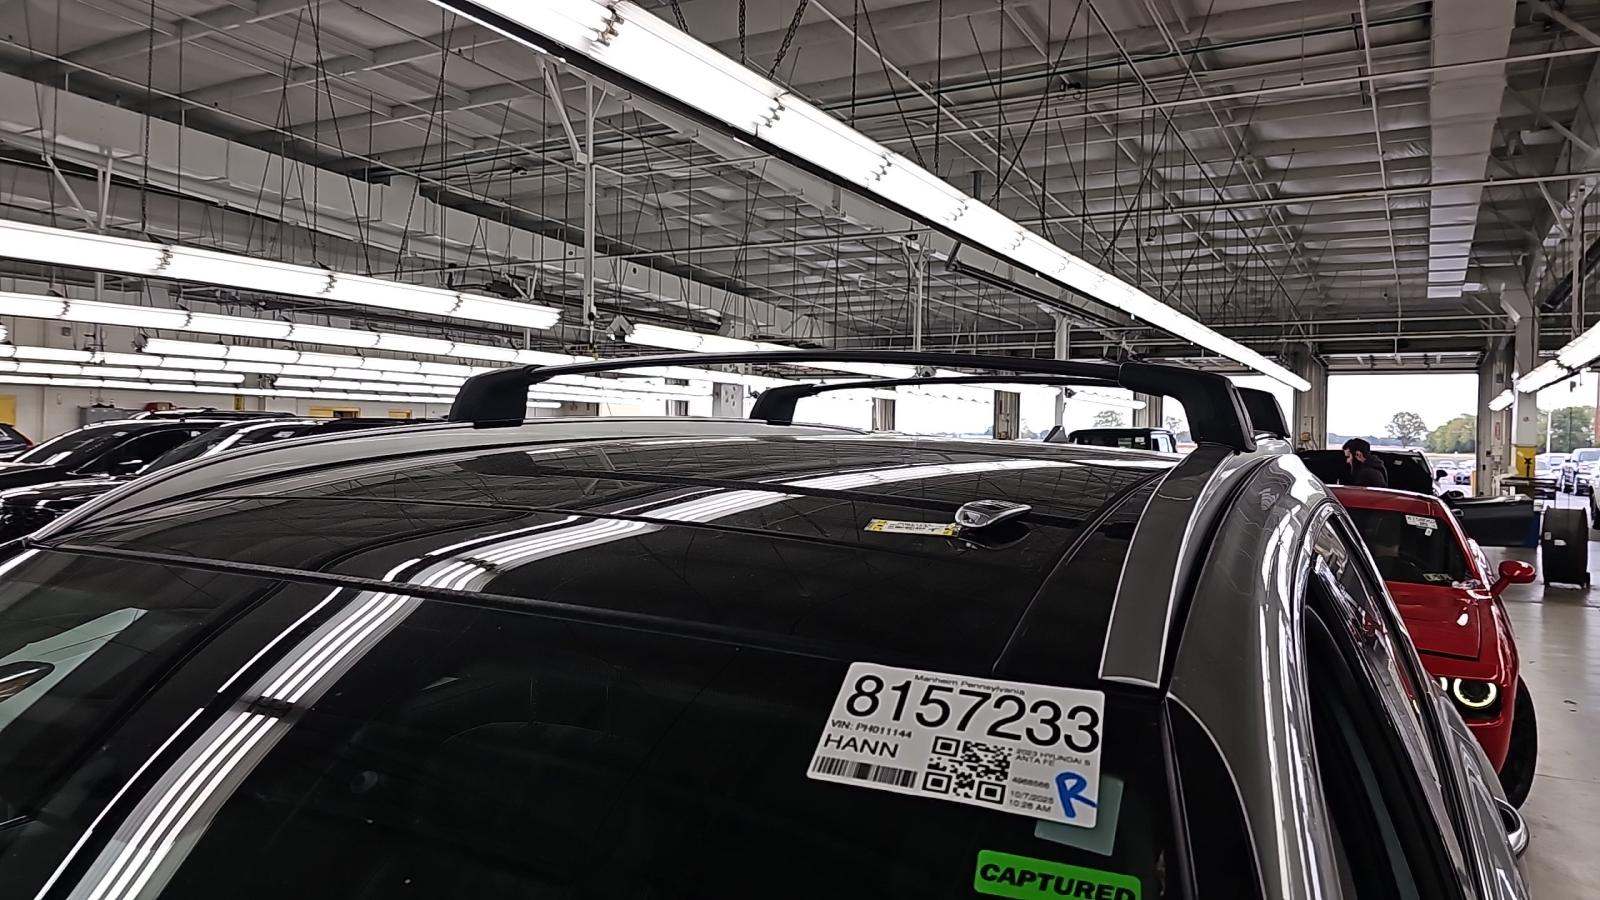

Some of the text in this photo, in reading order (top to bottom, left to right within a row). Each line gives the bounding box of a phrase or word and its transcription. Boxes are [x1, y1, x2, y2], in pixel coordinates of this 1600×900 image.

[914, 674, 958, 686] Manheim
[831, 719, 853, 730] VIN:
[846, 674, 1100, 753] 8157233
[824, 733, 899, 758] HANN
[1055, 772, 1099, 818] R
[1035, 804, 1052, 813] AM
[980, 863, 1137, 900] CAPTURED
